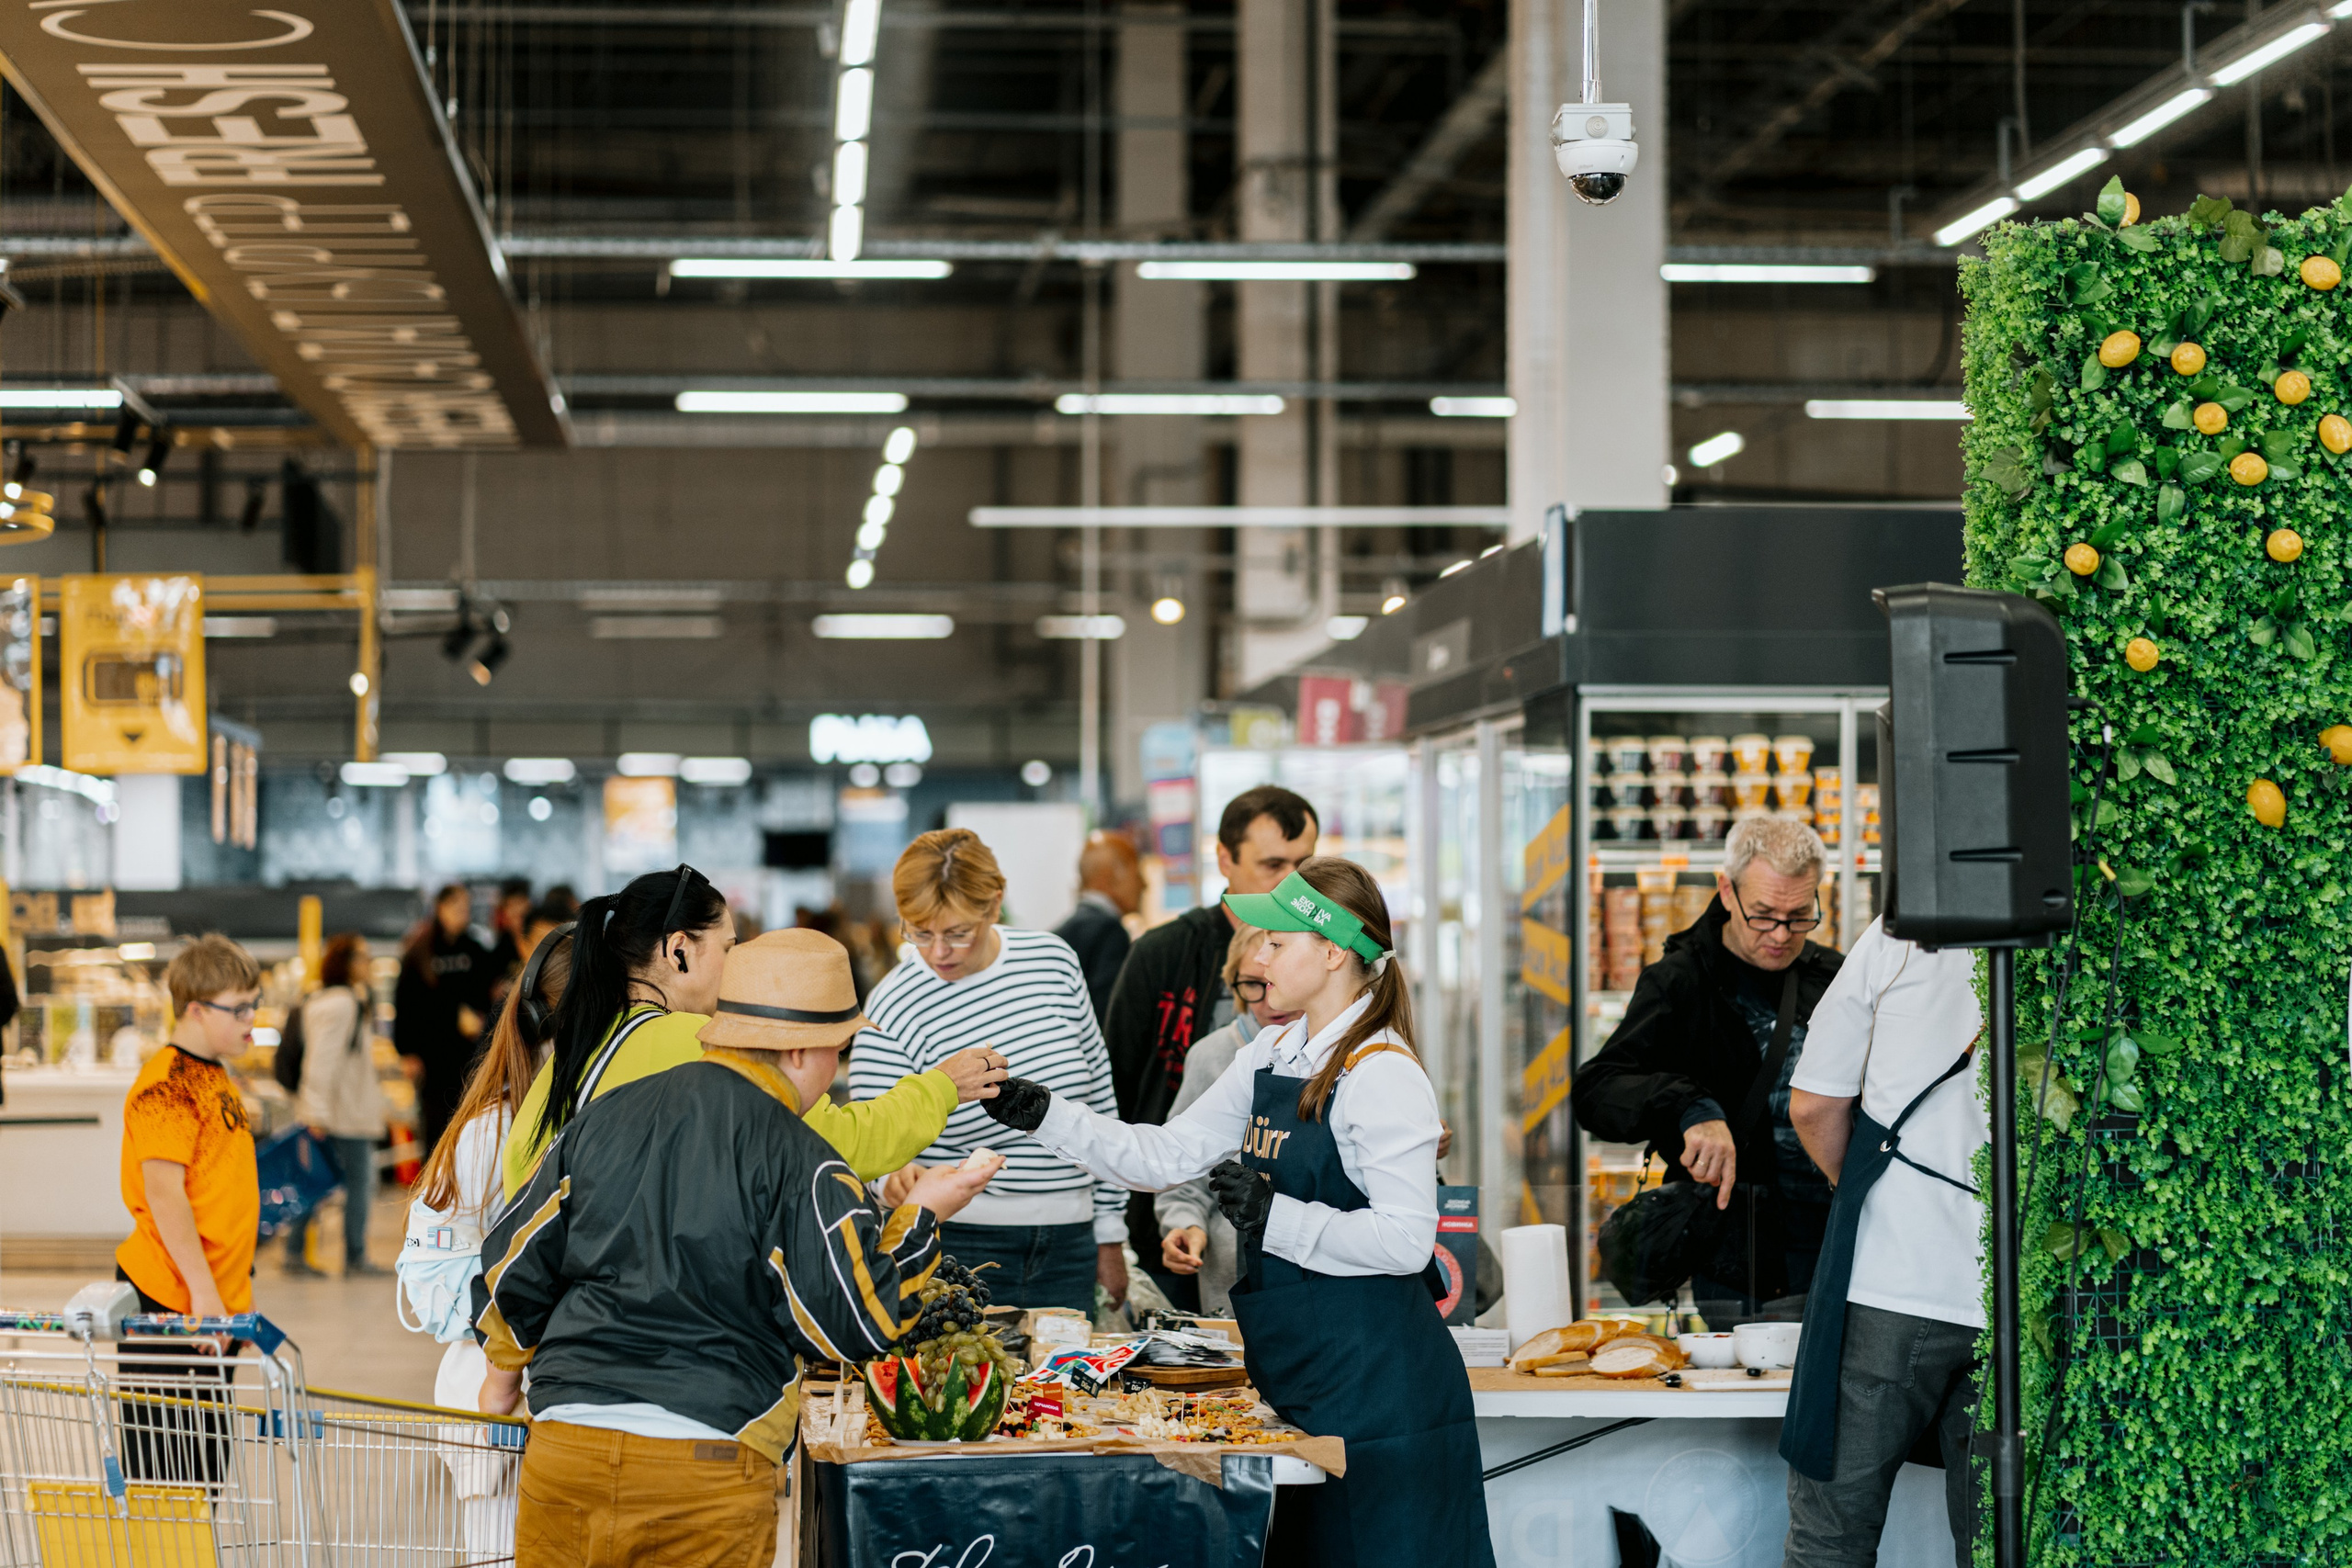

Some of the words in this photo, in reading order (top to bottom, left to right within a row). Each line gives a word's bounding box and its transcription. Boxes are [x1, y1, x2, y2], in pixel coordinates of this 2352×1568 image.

[75, 63, 387, 186] FRESH
[183, 193, 447, 309] БУРГЕР
[1291, 898, 1325, 926] ЭКОНИВА
[1299, 896, 1331, 922] EKONIVA
[1243, 1114, 1291, 1159] Dürr
